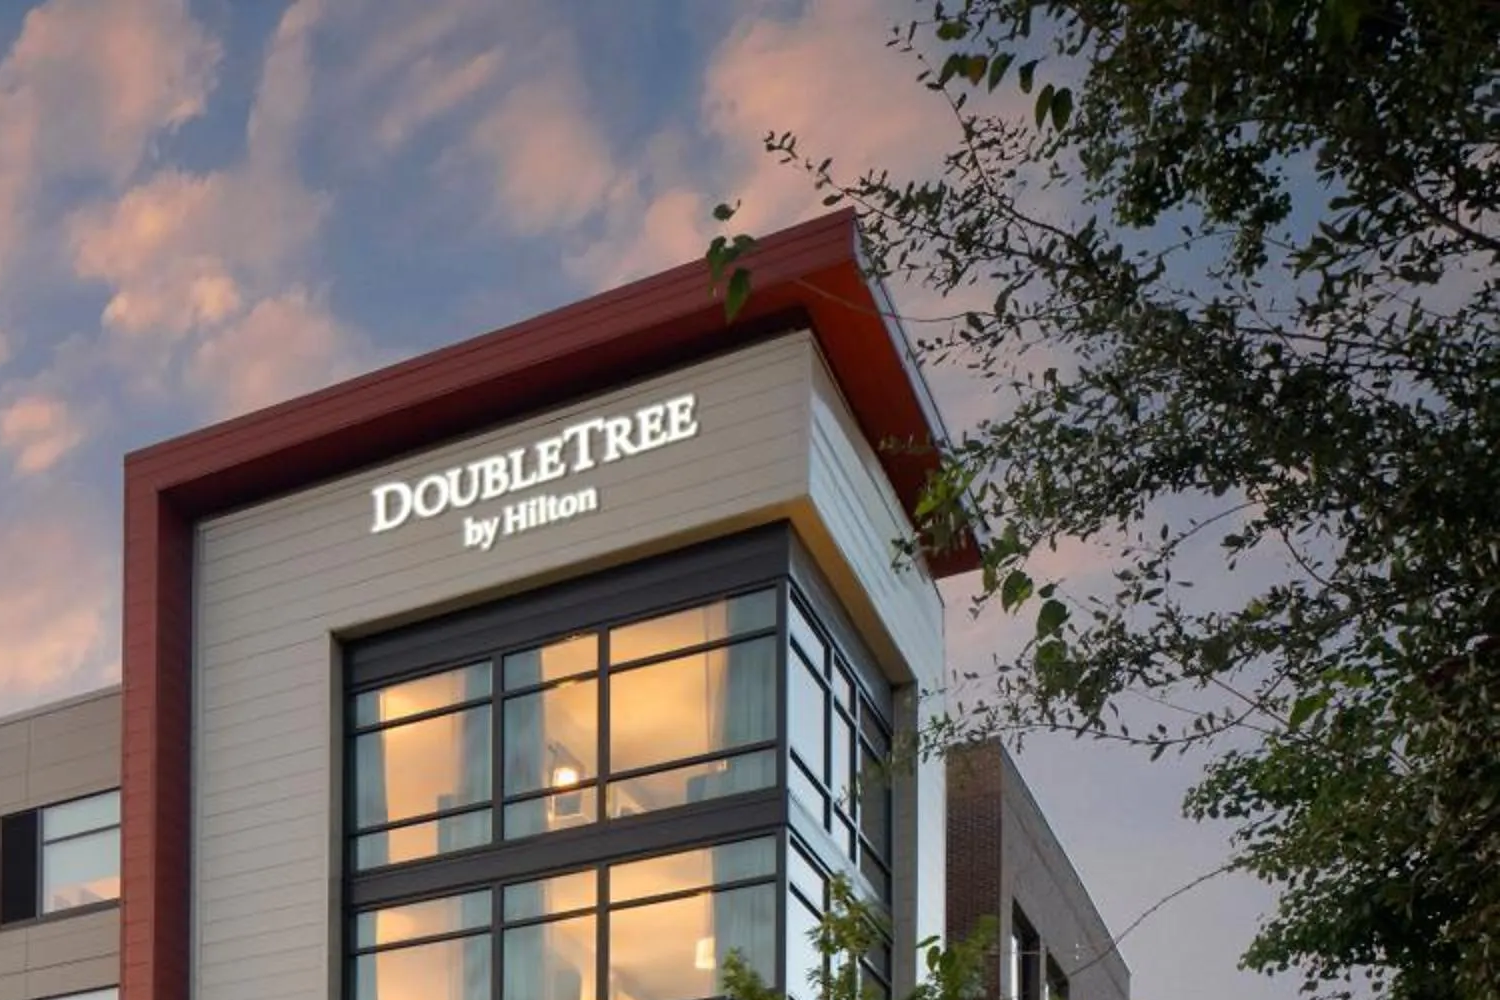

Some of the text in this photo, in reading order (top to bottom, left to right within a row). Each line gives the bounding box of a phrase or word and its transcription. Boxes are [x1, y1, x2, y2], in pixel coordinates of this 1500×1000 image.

[371, 393, 698, 533] DOUBLETREE
[463, 486, 598, 549] by Hilton
